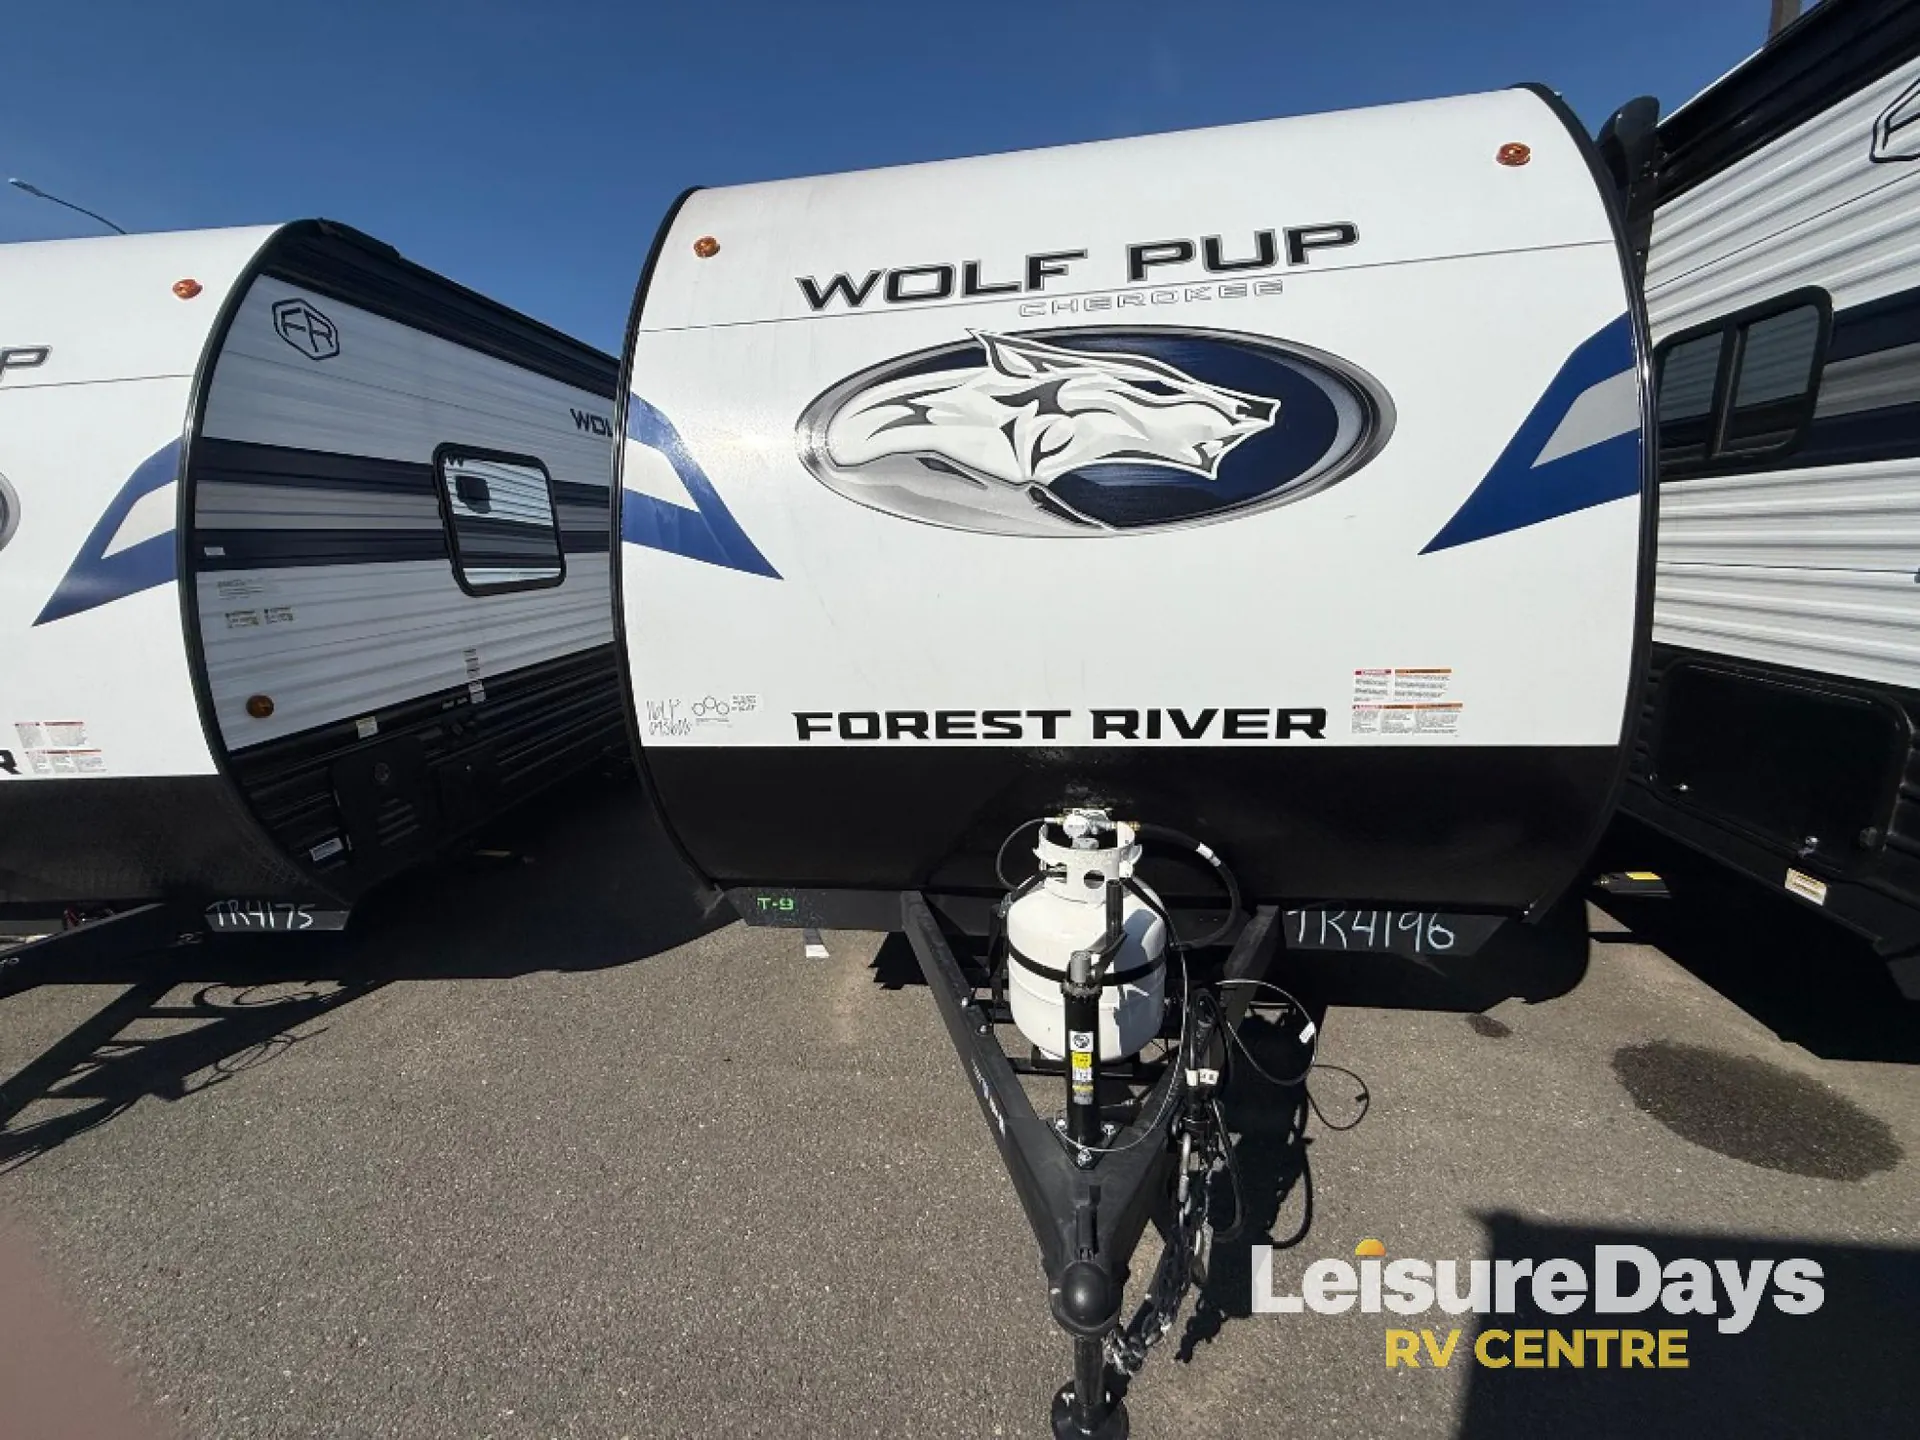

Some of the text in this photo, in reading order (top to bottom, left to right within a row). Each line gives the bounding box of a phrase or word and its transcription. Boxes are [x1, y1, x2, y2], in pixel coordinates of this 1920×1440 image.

[795, 220, 1360, 312] WOLF PUP
[1019, 279, 1284, 318] CHEROKEE
[791, 709, 1072, 741] FOREST
[1088, 707, 1328, 740] RIVER
[206, 900, 316, 930] TR4175
[1286, 903, 1455, 953] TR4196
